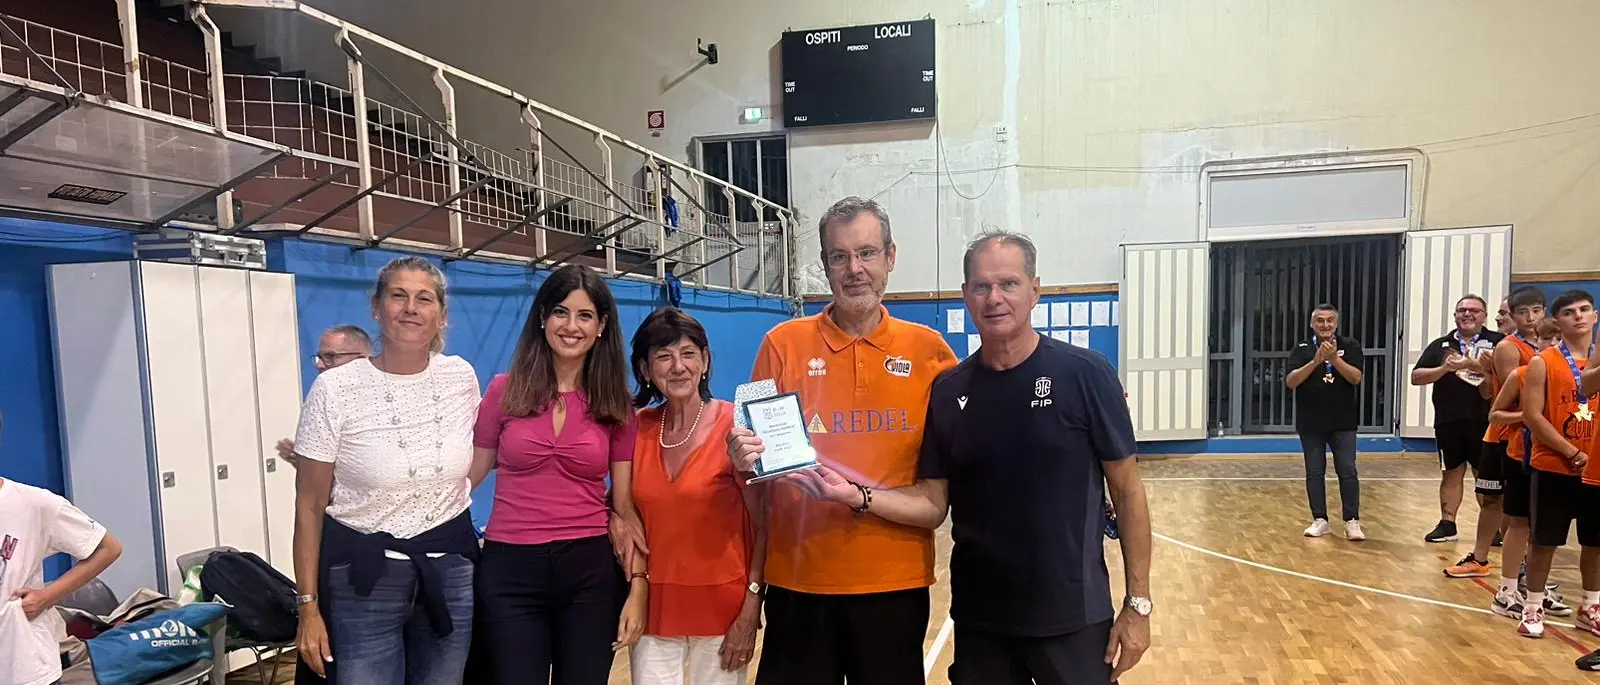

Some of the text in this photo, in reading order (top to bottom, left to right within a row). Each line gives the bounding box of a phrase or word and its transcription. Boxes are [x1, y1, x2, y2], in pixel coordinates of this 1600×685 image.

[805, 30, 841, 45] OSPITI
[874, 24, 912, 39] LOCALI
[846, 44, 869, 52] PERIODO
[1031, 399, 1053, 408] FIP
[831, 408, 914, 434] REDEL
[150, 639, 190, 648] OFFICIAL
